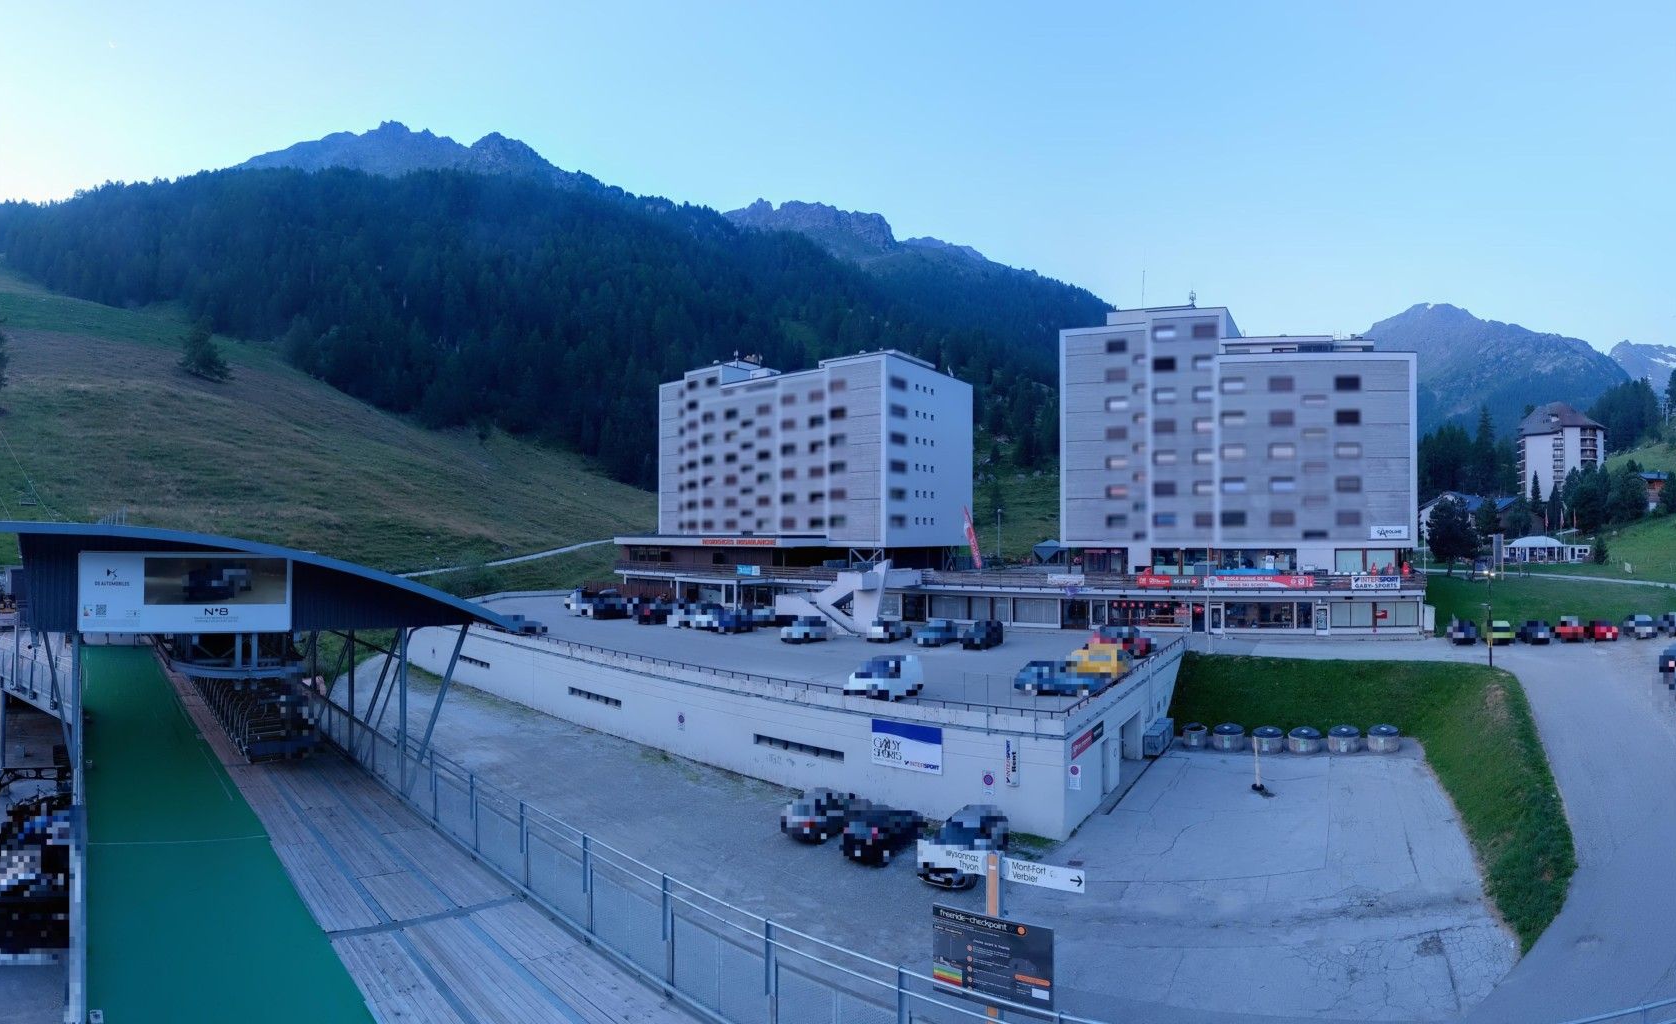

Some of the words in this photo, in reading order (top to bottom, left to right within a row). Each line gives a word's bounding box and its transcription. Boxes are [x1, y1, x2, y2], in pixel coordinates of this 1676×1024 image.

[909, 760, 940, 771] INTERSPORT
[959, 860, 979, 872] Thyon
[1011, 861, 1046, 875] Mont-Fort
[1012, 871, 1038, 883] Verbier
